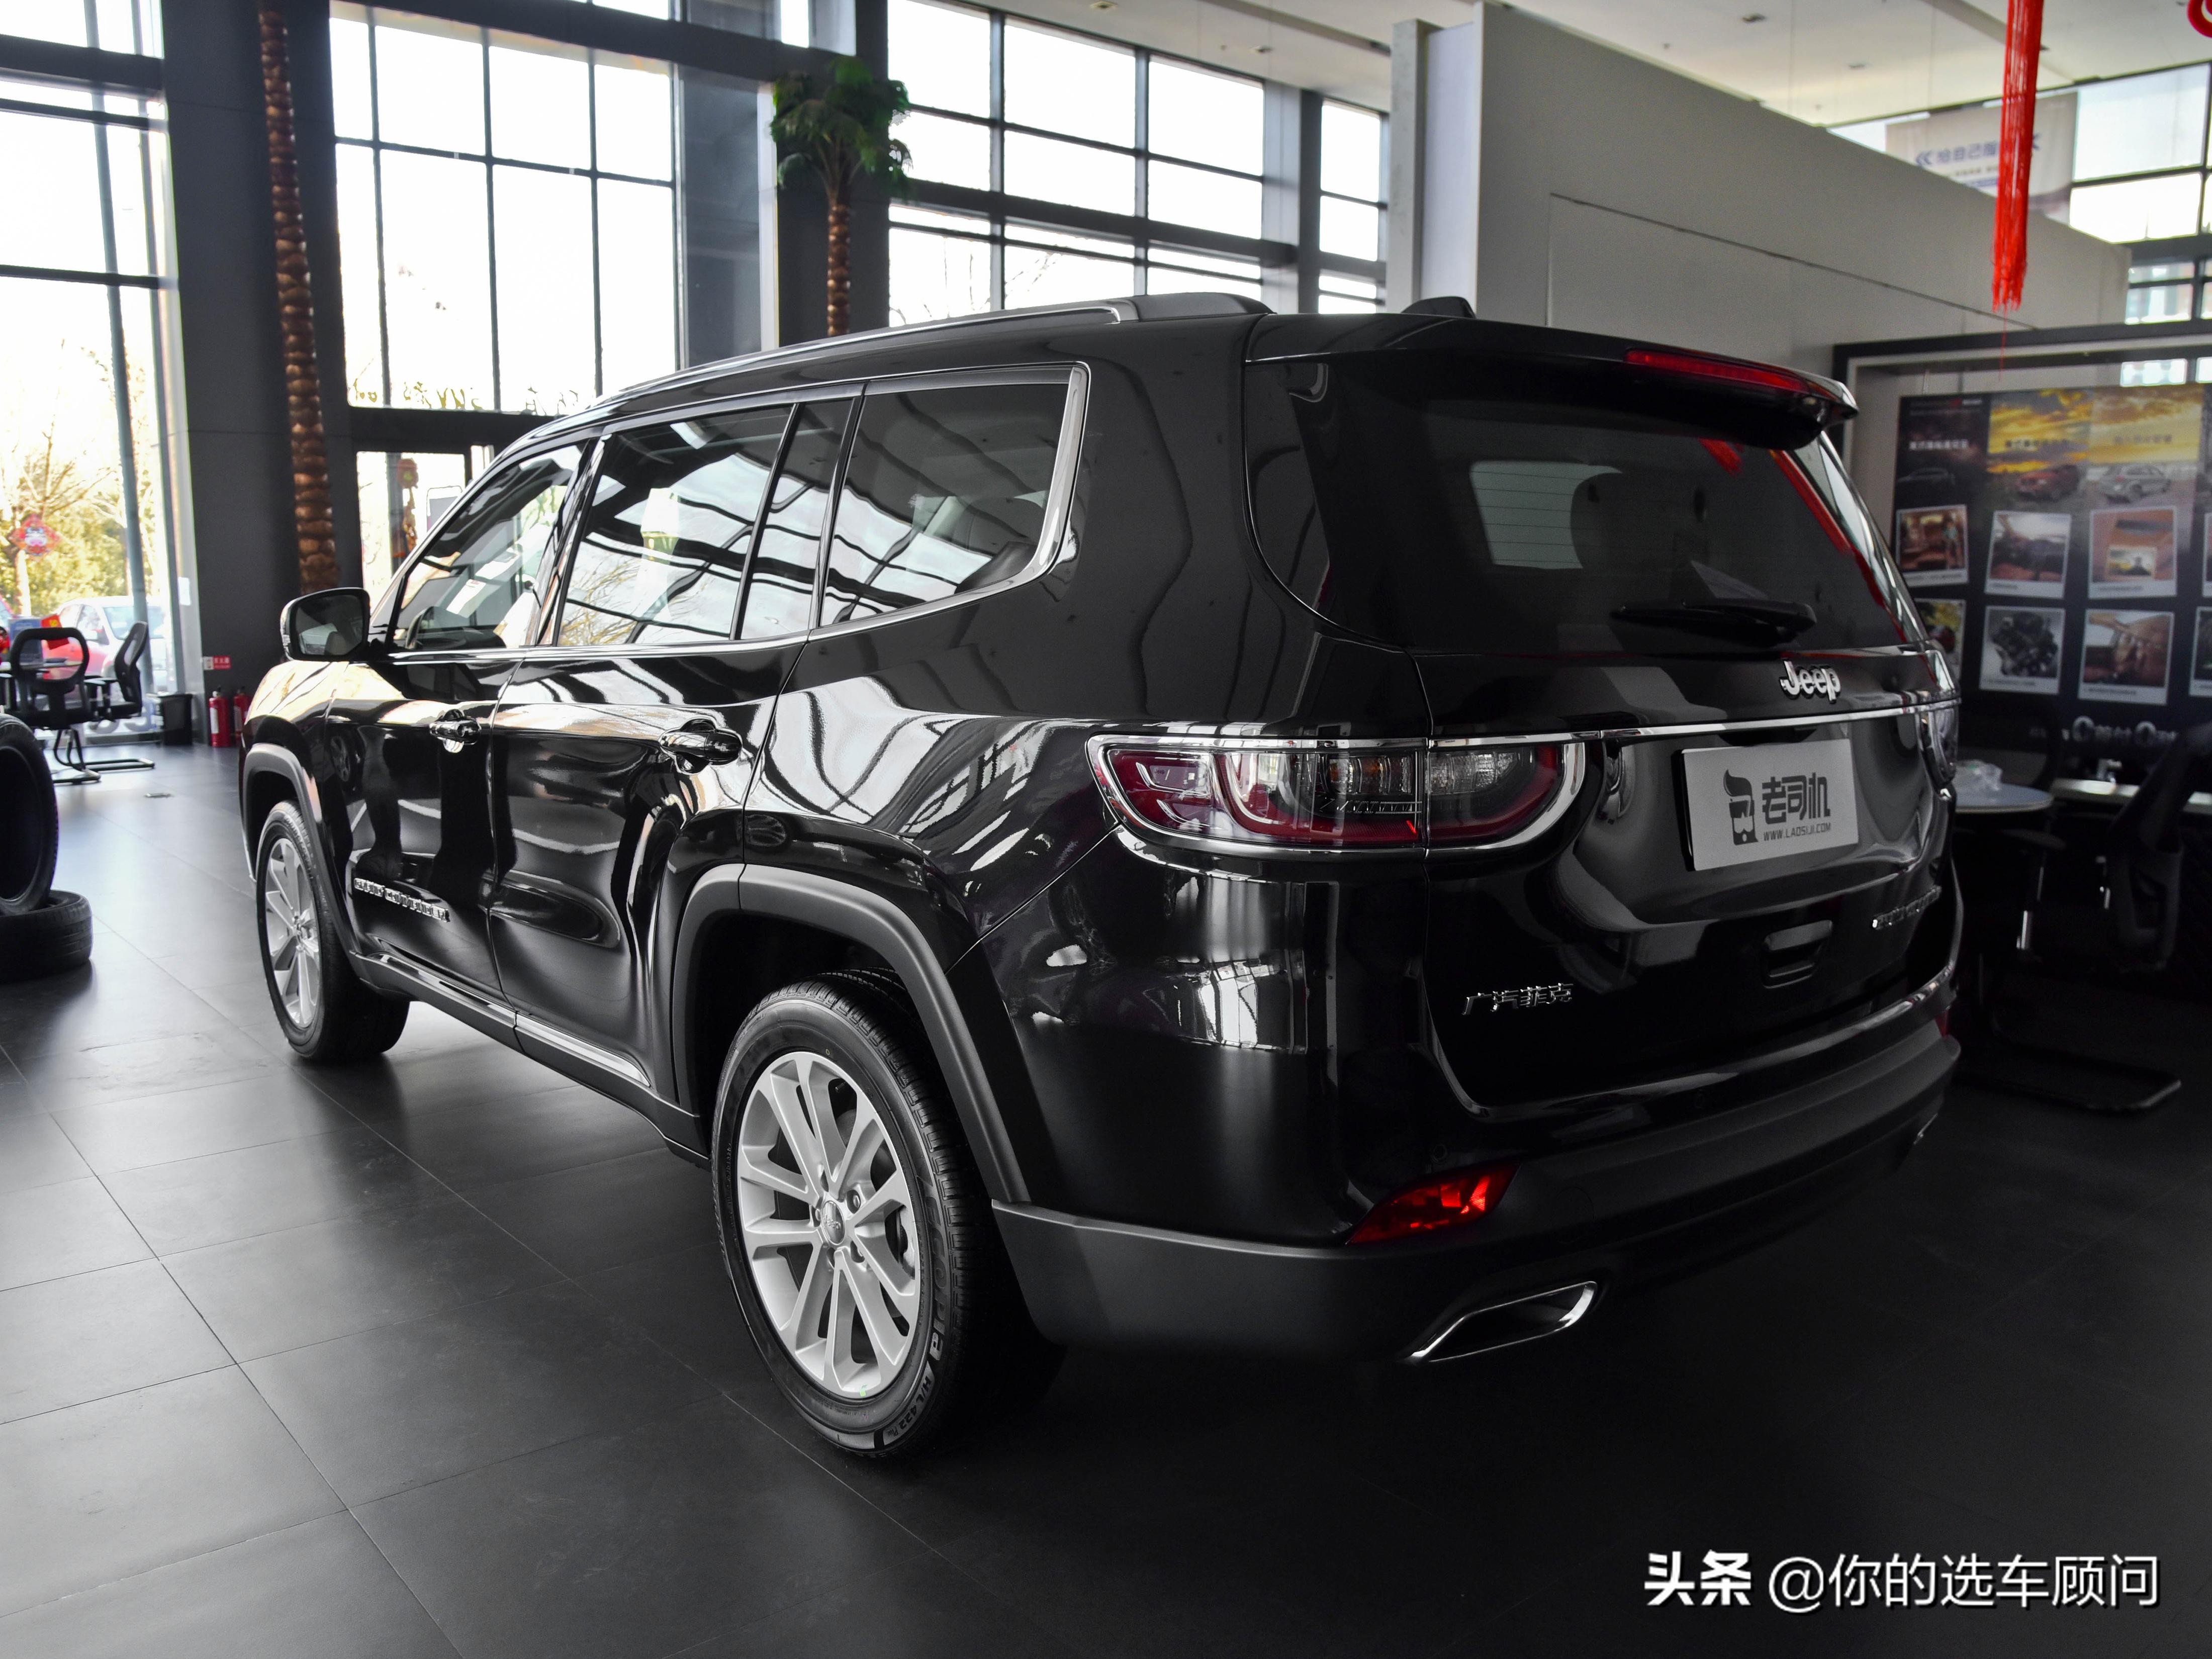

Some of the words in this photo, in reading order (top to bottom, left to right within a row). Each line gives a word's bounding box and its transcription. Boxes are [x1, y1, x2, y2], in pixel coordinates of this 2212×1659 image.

[1780, 660, 1840, 702] Jeep
[1762, 772, 1830, 824] 老司机
[1764, 822, 1831, 841] WWW.LAOSIJI.COM
[1461, 983, 1573, 1015] 广汽菲克
[899, 1405, 917, 1430] 422
